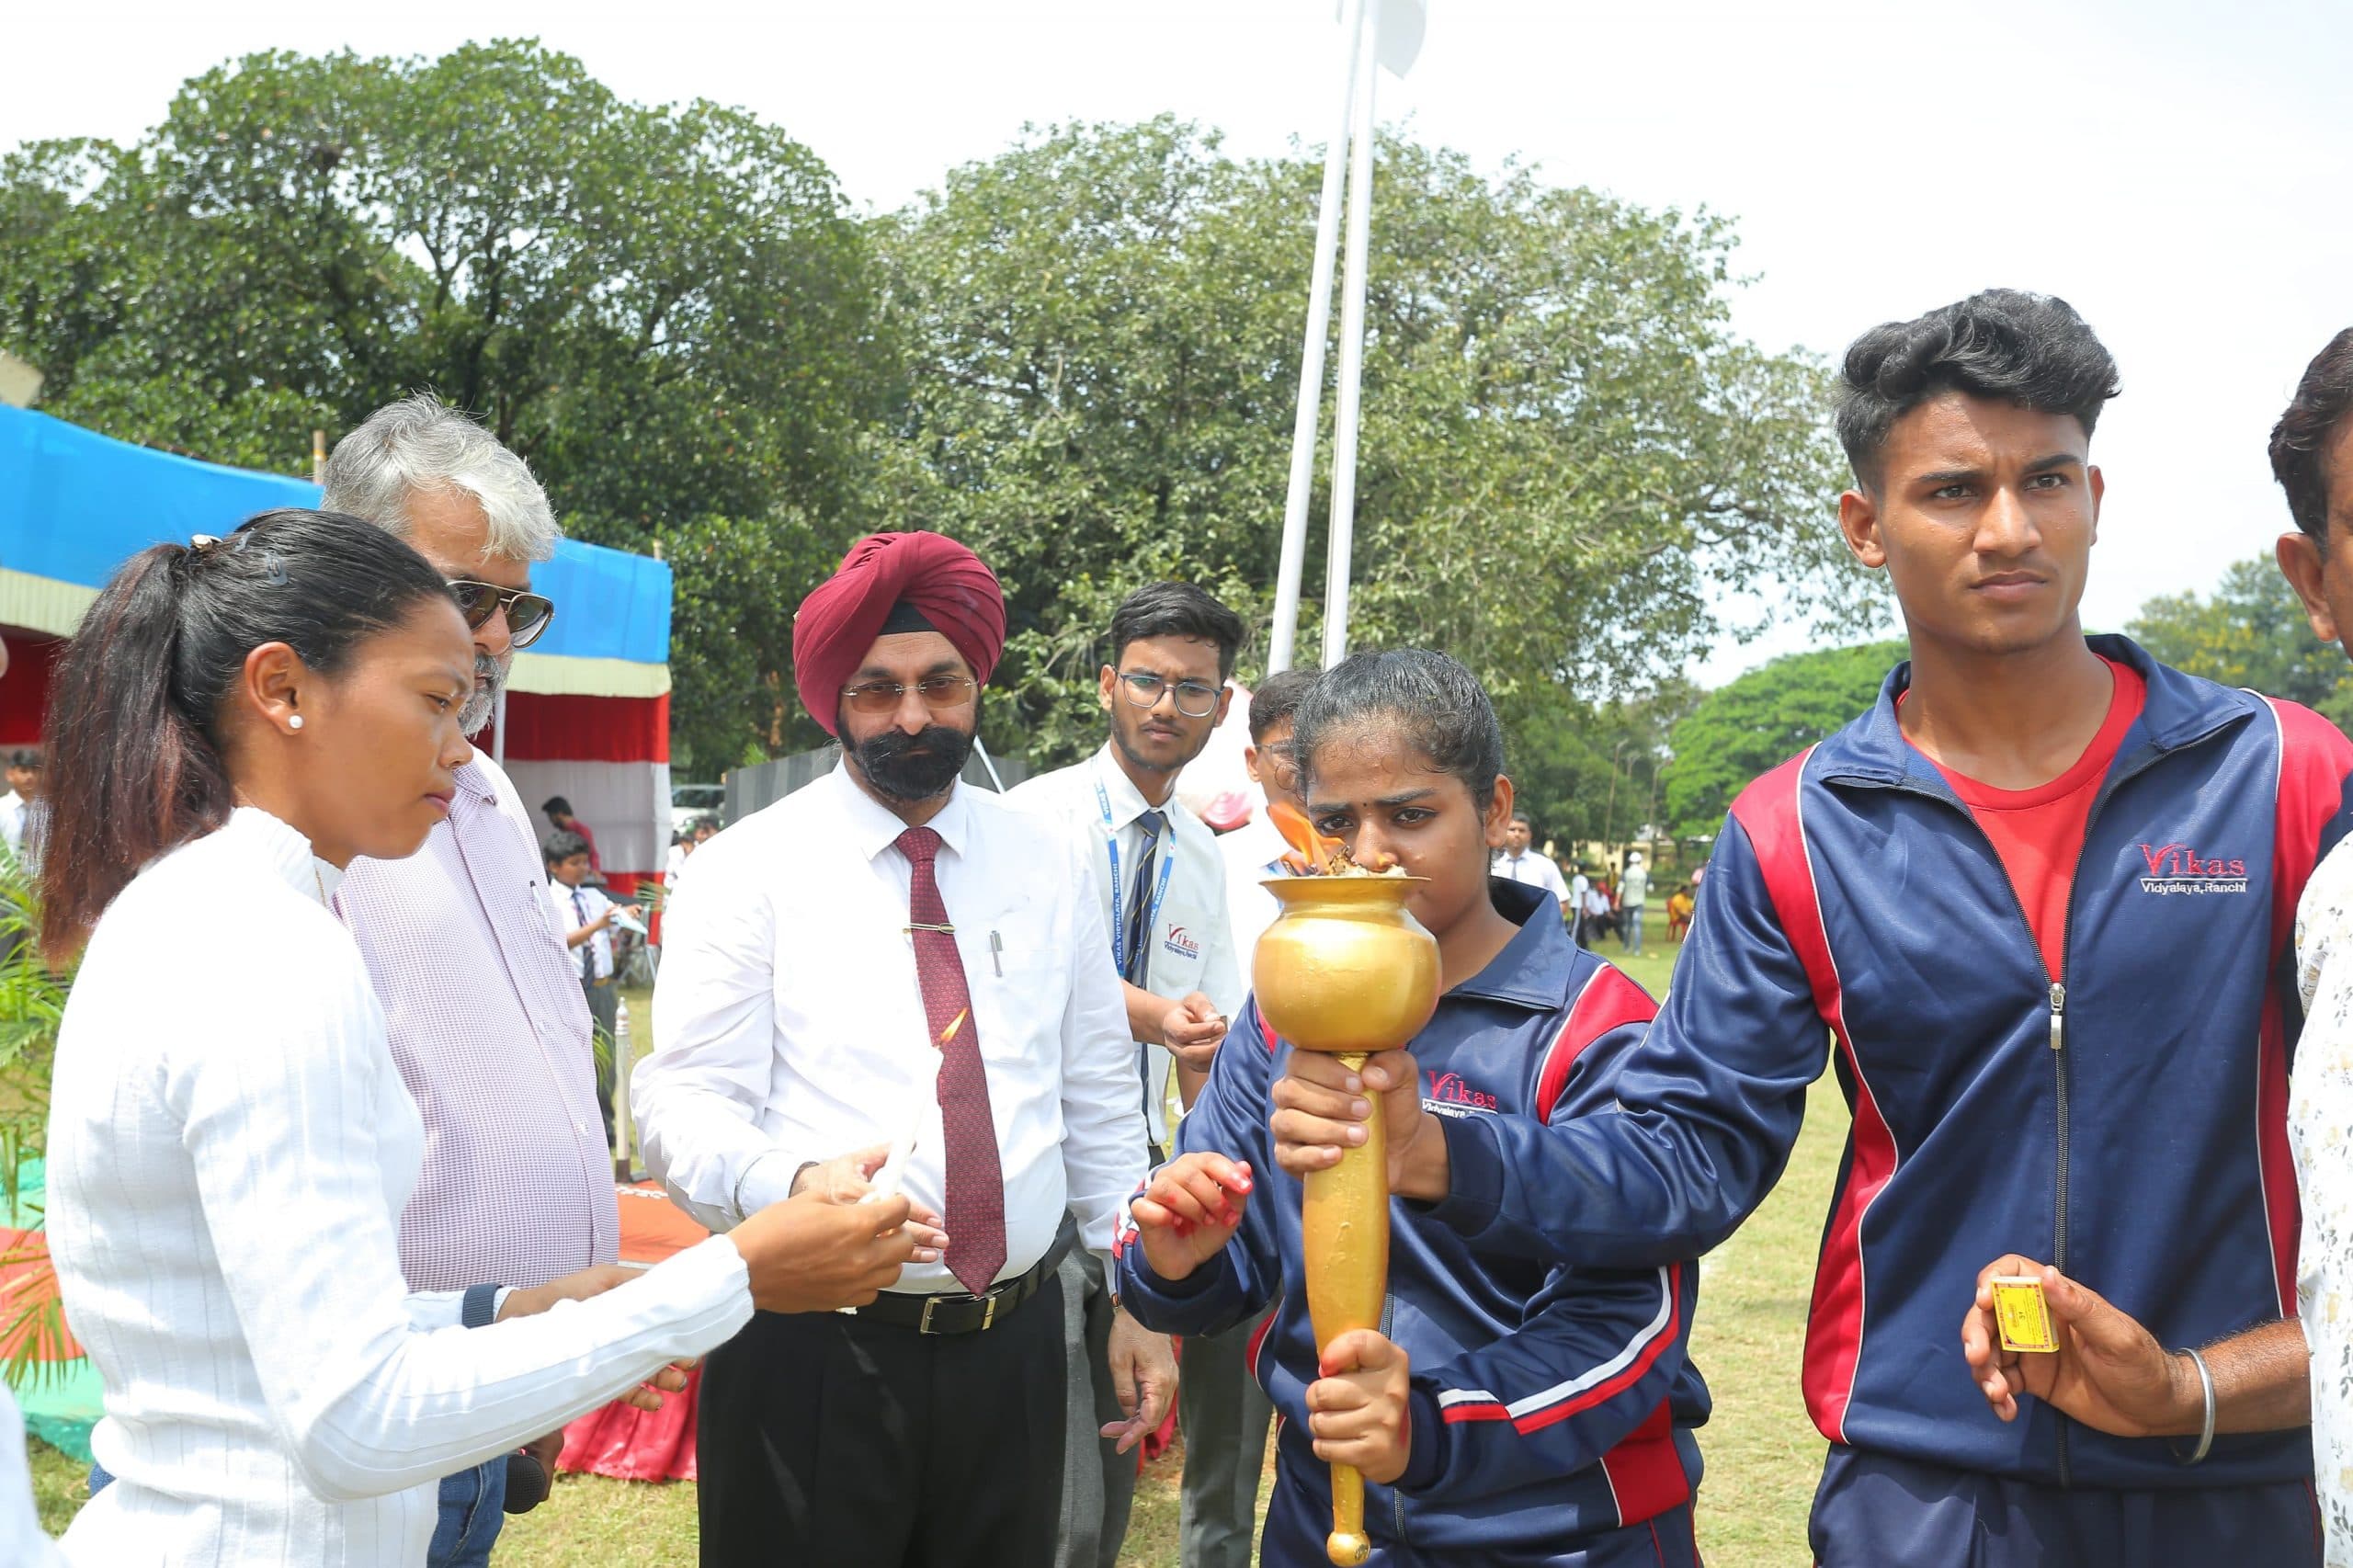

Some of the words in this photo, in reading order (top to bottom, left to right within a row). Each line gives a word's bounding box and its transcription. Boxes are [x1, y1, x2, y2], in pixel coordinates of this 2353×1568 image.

[2138, 844, 2245, 876] Vikas
[1168, 923, 1199, 950] Vikas
[1427, 1070, 1497, 1109] Vikas
